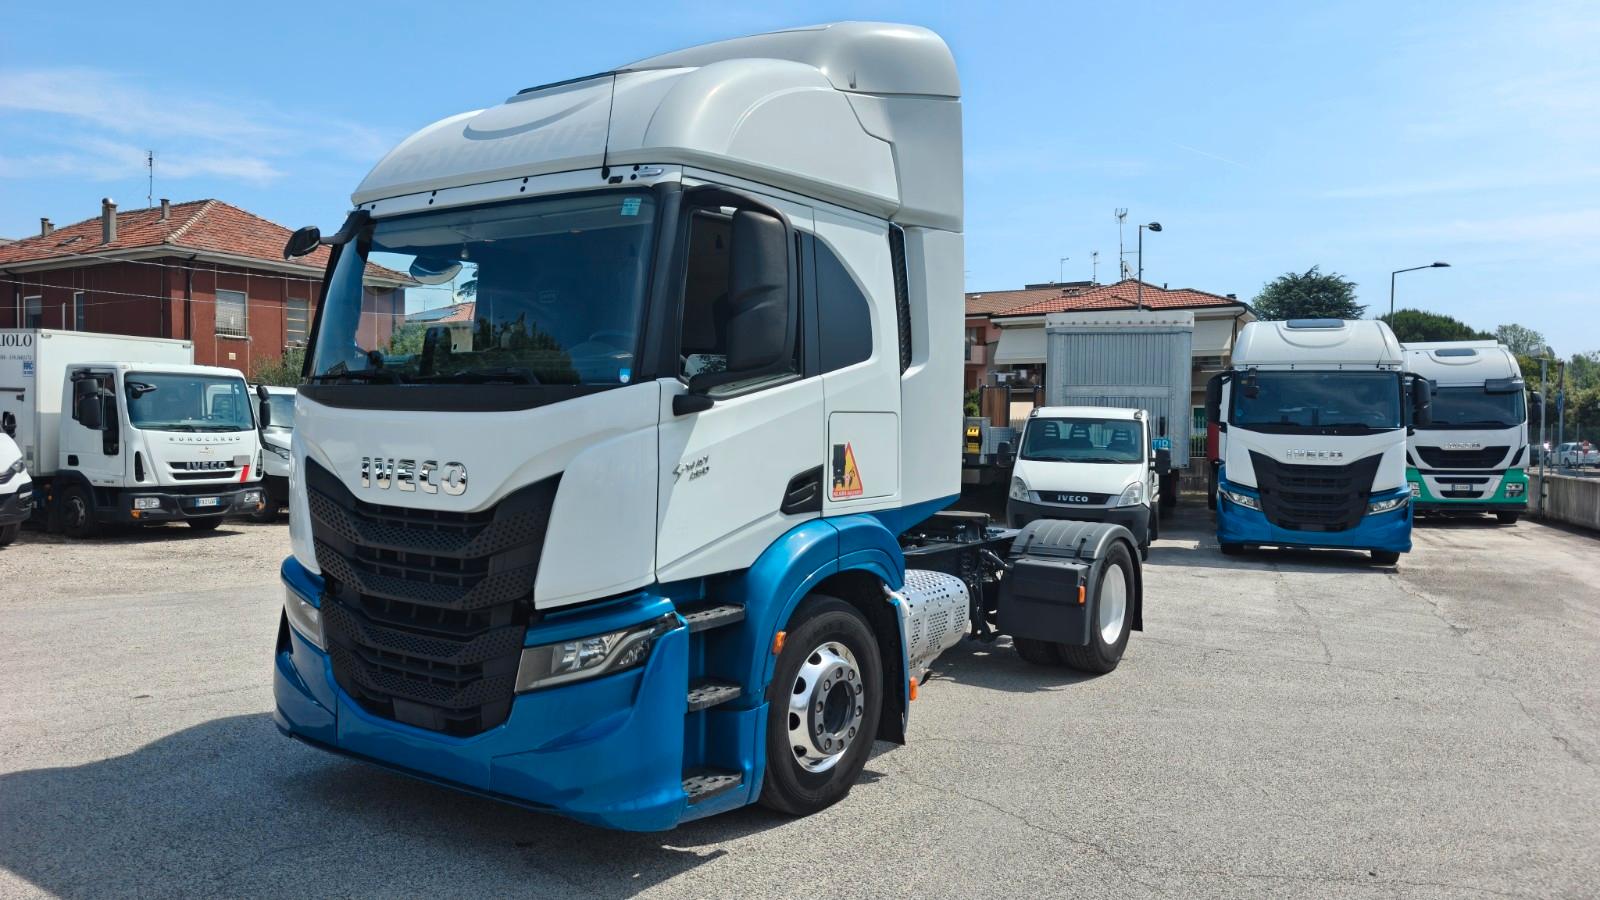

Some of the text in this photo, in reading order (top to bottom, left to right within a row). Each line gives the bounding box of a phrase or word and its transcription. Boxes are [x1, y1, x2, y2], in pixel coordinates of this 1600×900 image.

[0, 333, 33, 347] IOLO
[1286, 448, 1344, 461] IVECO
[186, 461, 227, 471] IVECO
[361, 456, 469, 497] IVECO
[1057, 494, 1089, 503] IVECO
